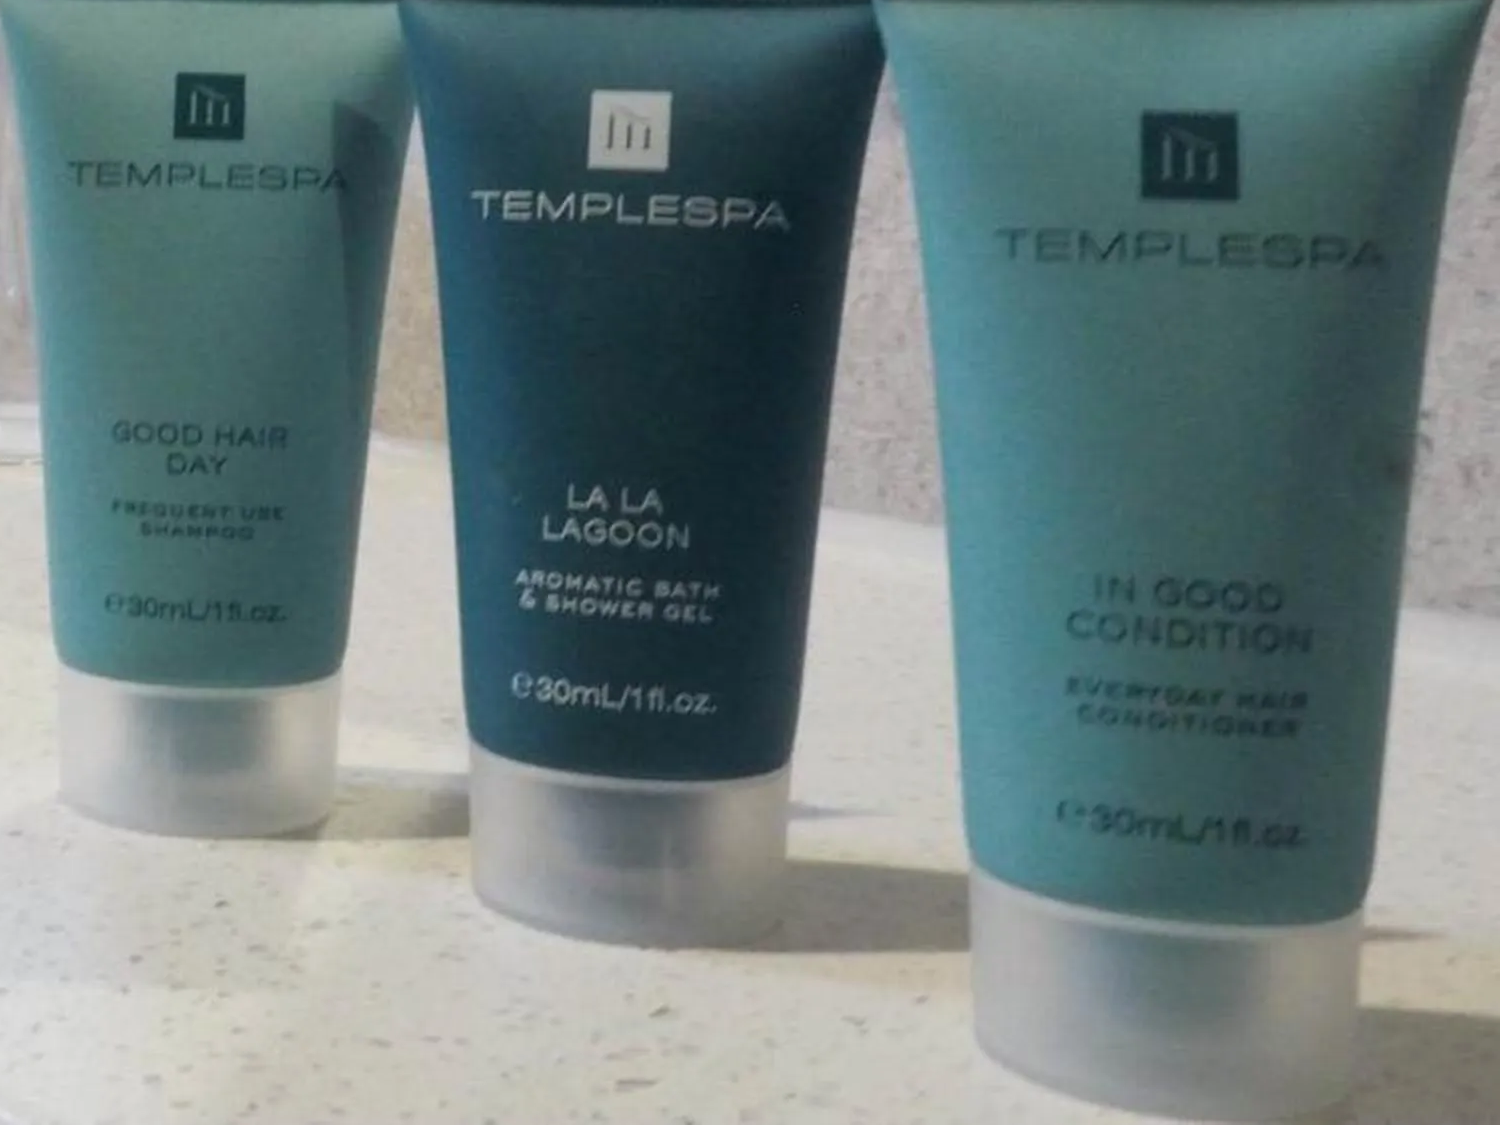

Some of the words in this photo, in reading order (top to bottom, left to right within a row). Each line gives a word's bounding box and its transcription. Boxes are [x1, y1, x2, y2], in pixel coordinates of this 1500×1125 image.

[67, 159, 349, 193] TEMPLESPA
[471, 189, 791, 231] TEMPLESPA
[994, 227, 1388, 271] TEMPLESPA
[112, 420, 204, 448] GOOD
[214, 425, 289, 450] HAIR
[166, 451, 228, 477] DAY
[111, 497, 234, 521] FREQUENT
[566, 483, 609, 513] LA
[620, 486, 664, 516] LA
[139, 521, 256, 542] SHAMPOO
[542, 515, 690, 551] LAGOON
[515, 568, 644, 598] AROMATIC
[653, 578, 722, 601] BATH
[1093, 575, 1136, 606] IN
[1153, 576, 1283, 614] GOOD
[517, 587, 537, 610] &
[545, 593, 655, 620] SHOWER
[662, 602, 715, 625] GEL
[1065, 607, 1314, 655] CONDITION
